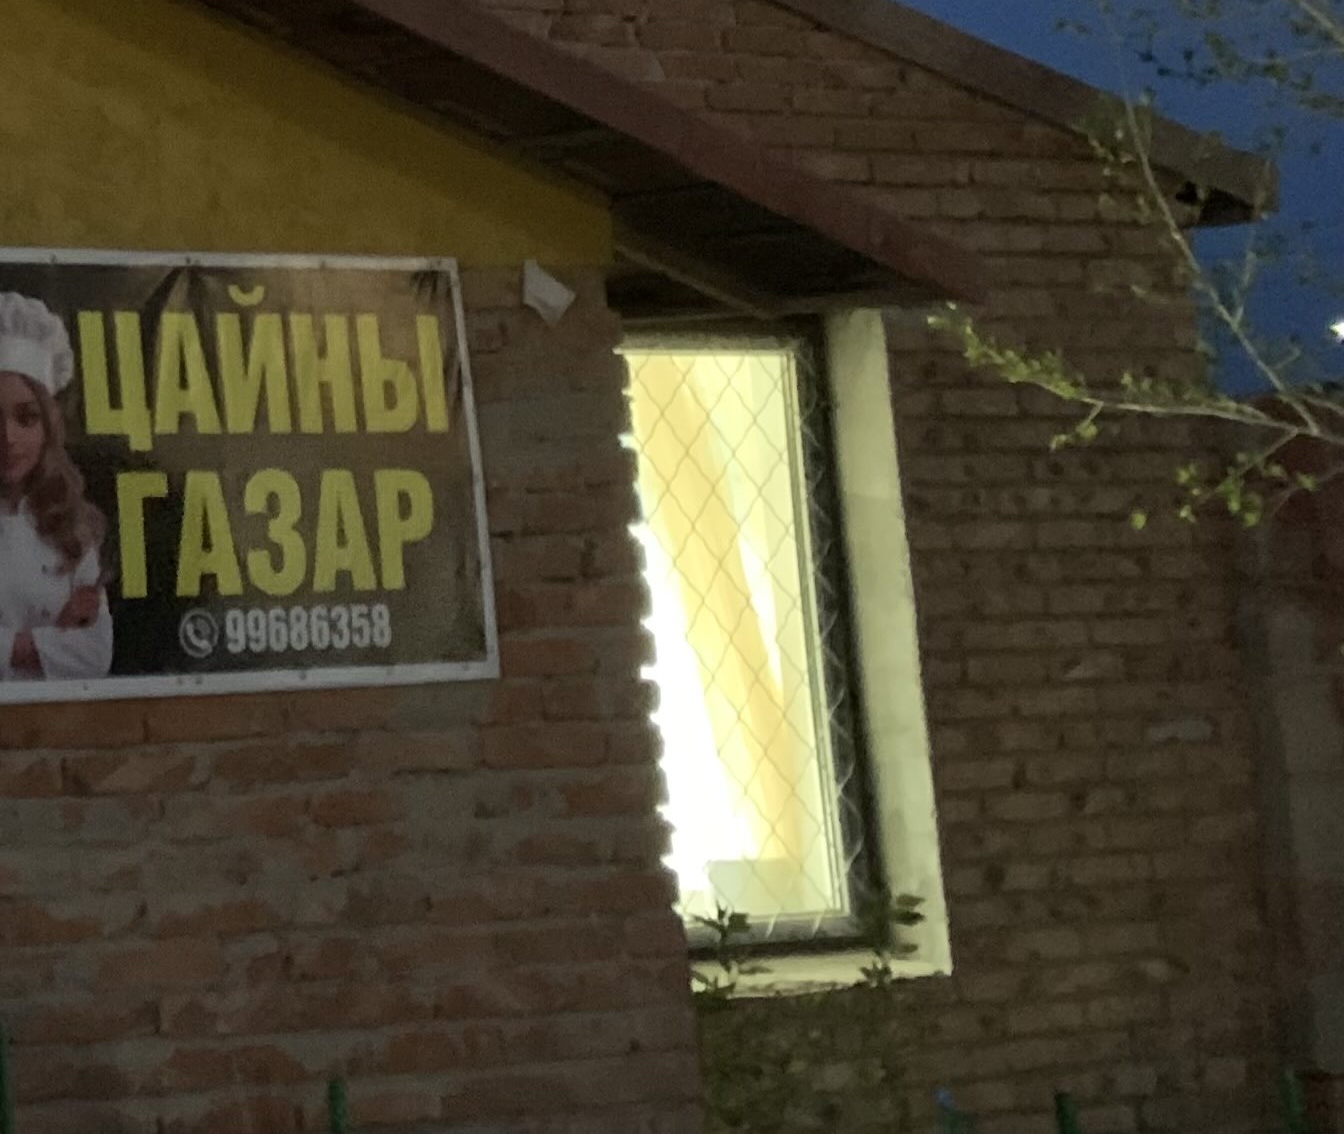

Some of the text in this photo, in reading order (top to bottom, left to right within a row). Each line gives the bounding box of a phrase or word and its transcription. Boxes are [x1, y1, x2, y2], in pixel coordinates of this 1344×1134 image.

[78, 285, 449, 452] ЦАЙНЫ
[115, 468, 435, 599] ГАЗАР
[224, 602, 393, 654] 99686358
